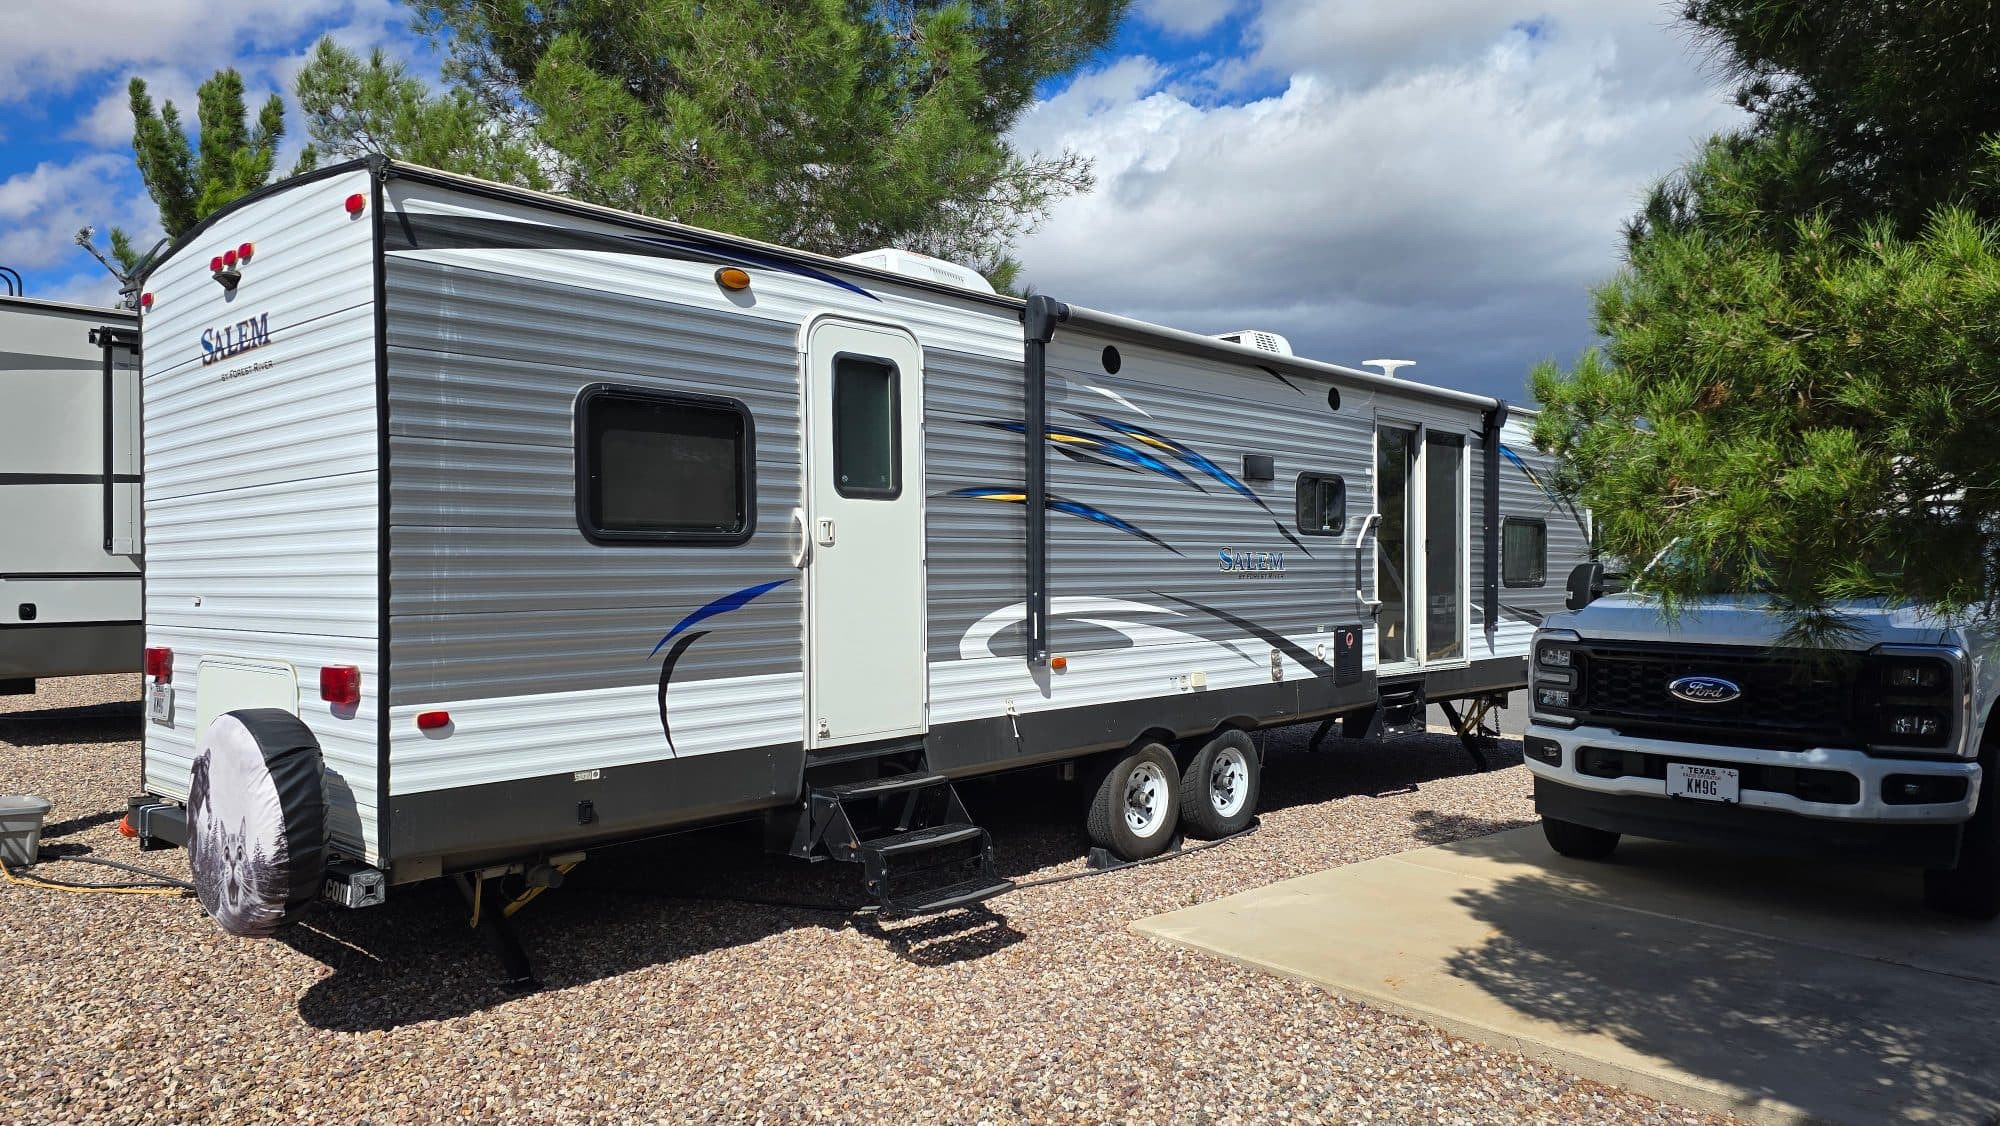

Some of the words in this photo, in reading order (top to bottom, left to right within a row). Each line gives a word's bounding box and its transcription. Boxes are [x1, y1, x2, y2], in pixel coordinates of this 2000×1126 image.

[201, 312, 272, 367] SALEM
[1218, 546, 1286, 571] SALEM
[1685, 681, 1724, 698] Ford
[1687, 766, 1717, 776] TEXAS
